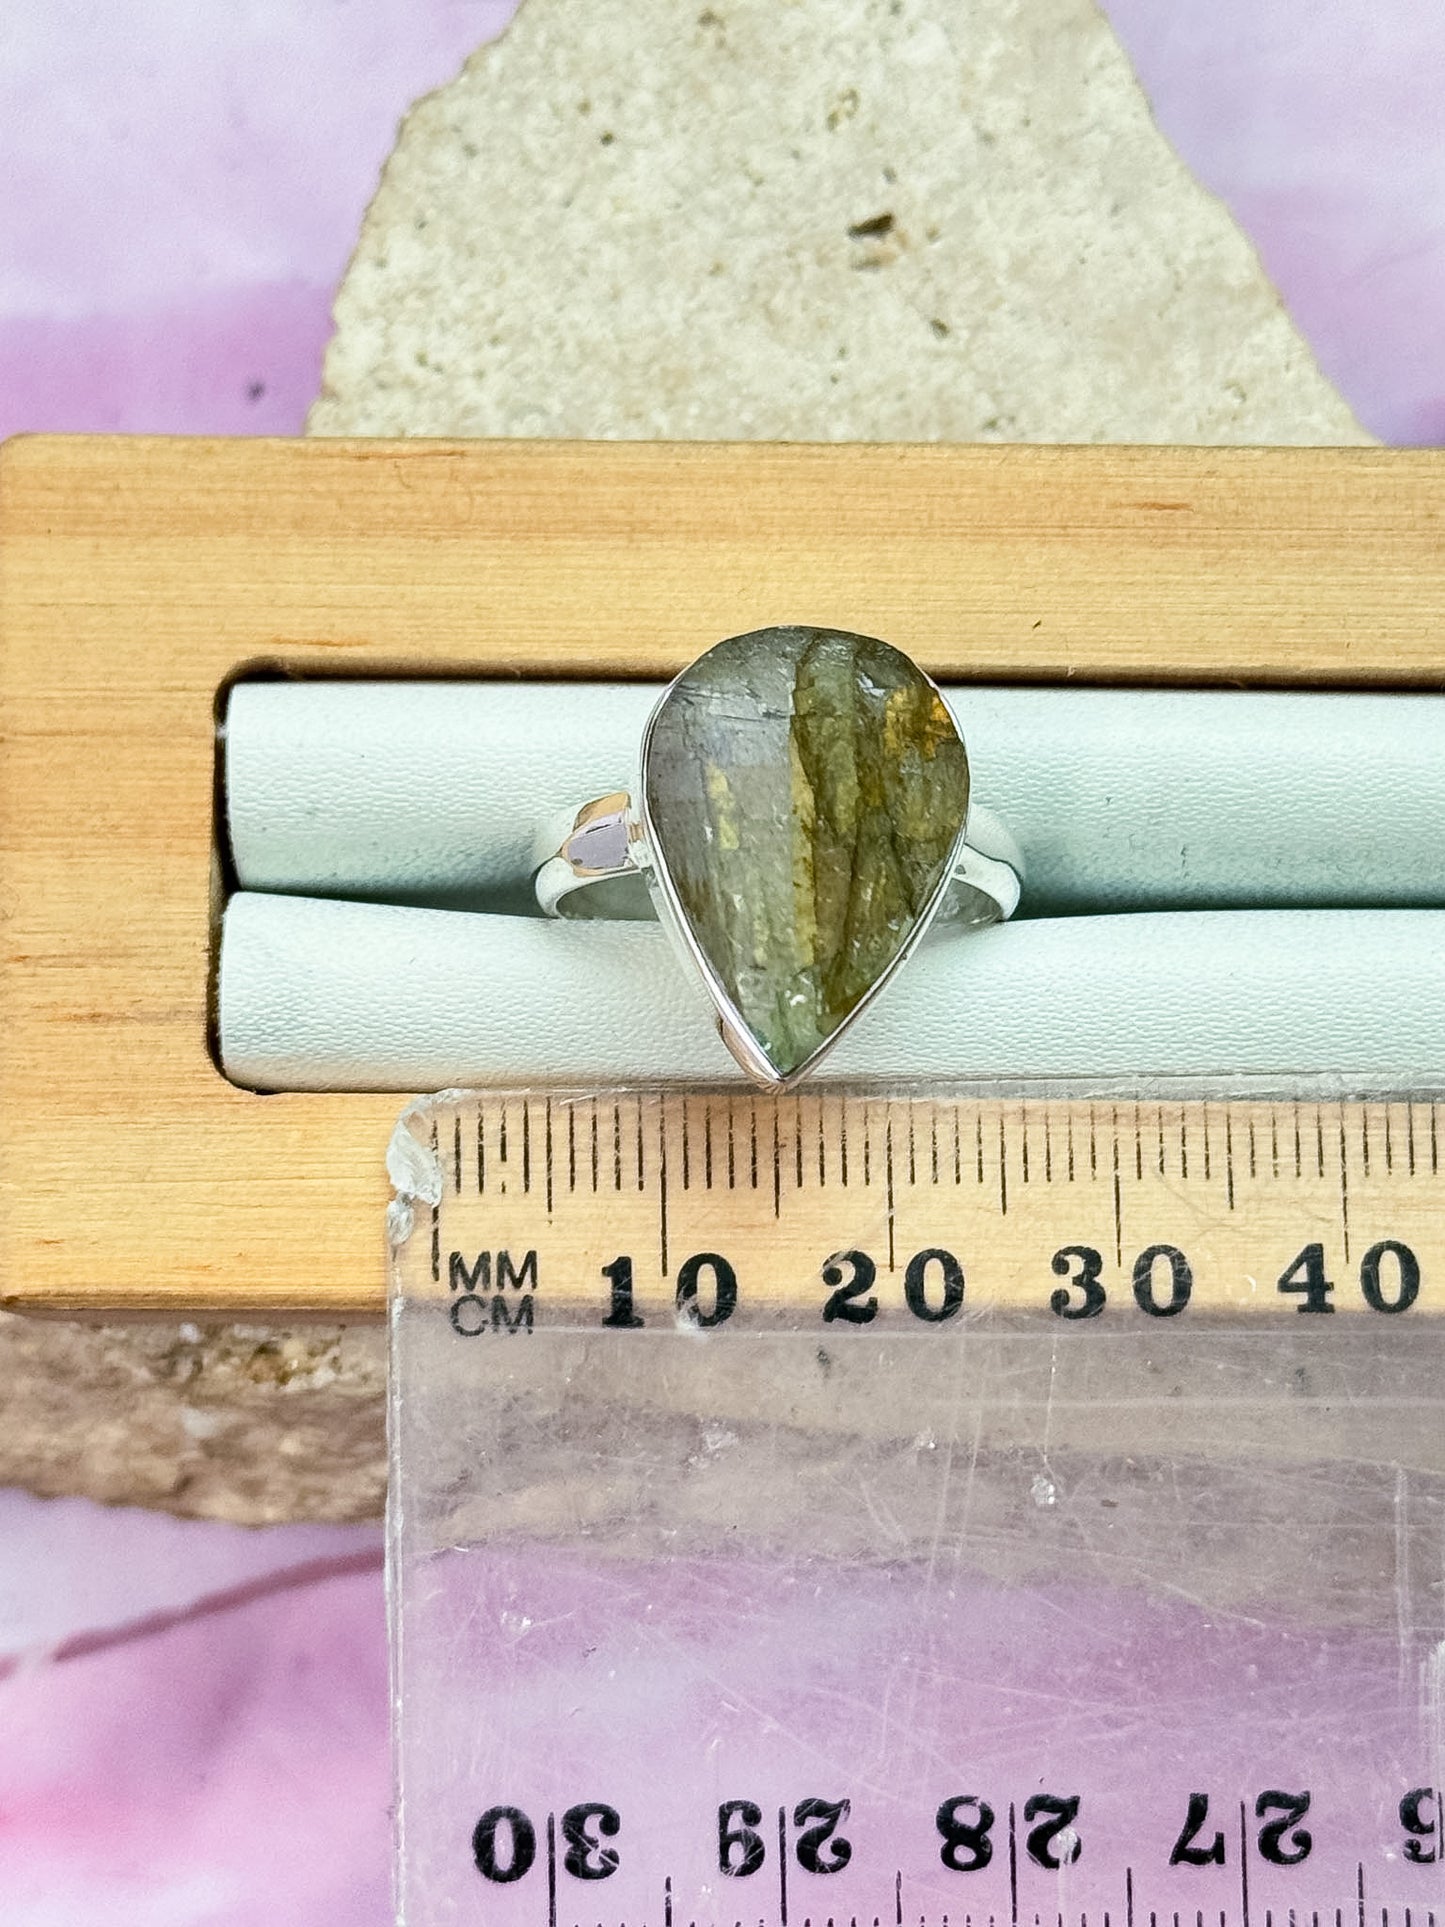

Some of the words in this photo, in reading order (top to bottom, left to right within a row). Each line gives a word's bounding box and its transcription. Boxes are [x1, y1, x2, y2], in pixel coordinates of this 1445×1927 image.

[448, 1249, 538, 1291] MM
[601, 1252, 738, 1328] 10
[821, 1247, 965, 1324] 20
[1049, 1244, 1193, 1320] 30
[1276, 1239, 1421, 1315] 40
[449, 1293, 535, 1337] CM
